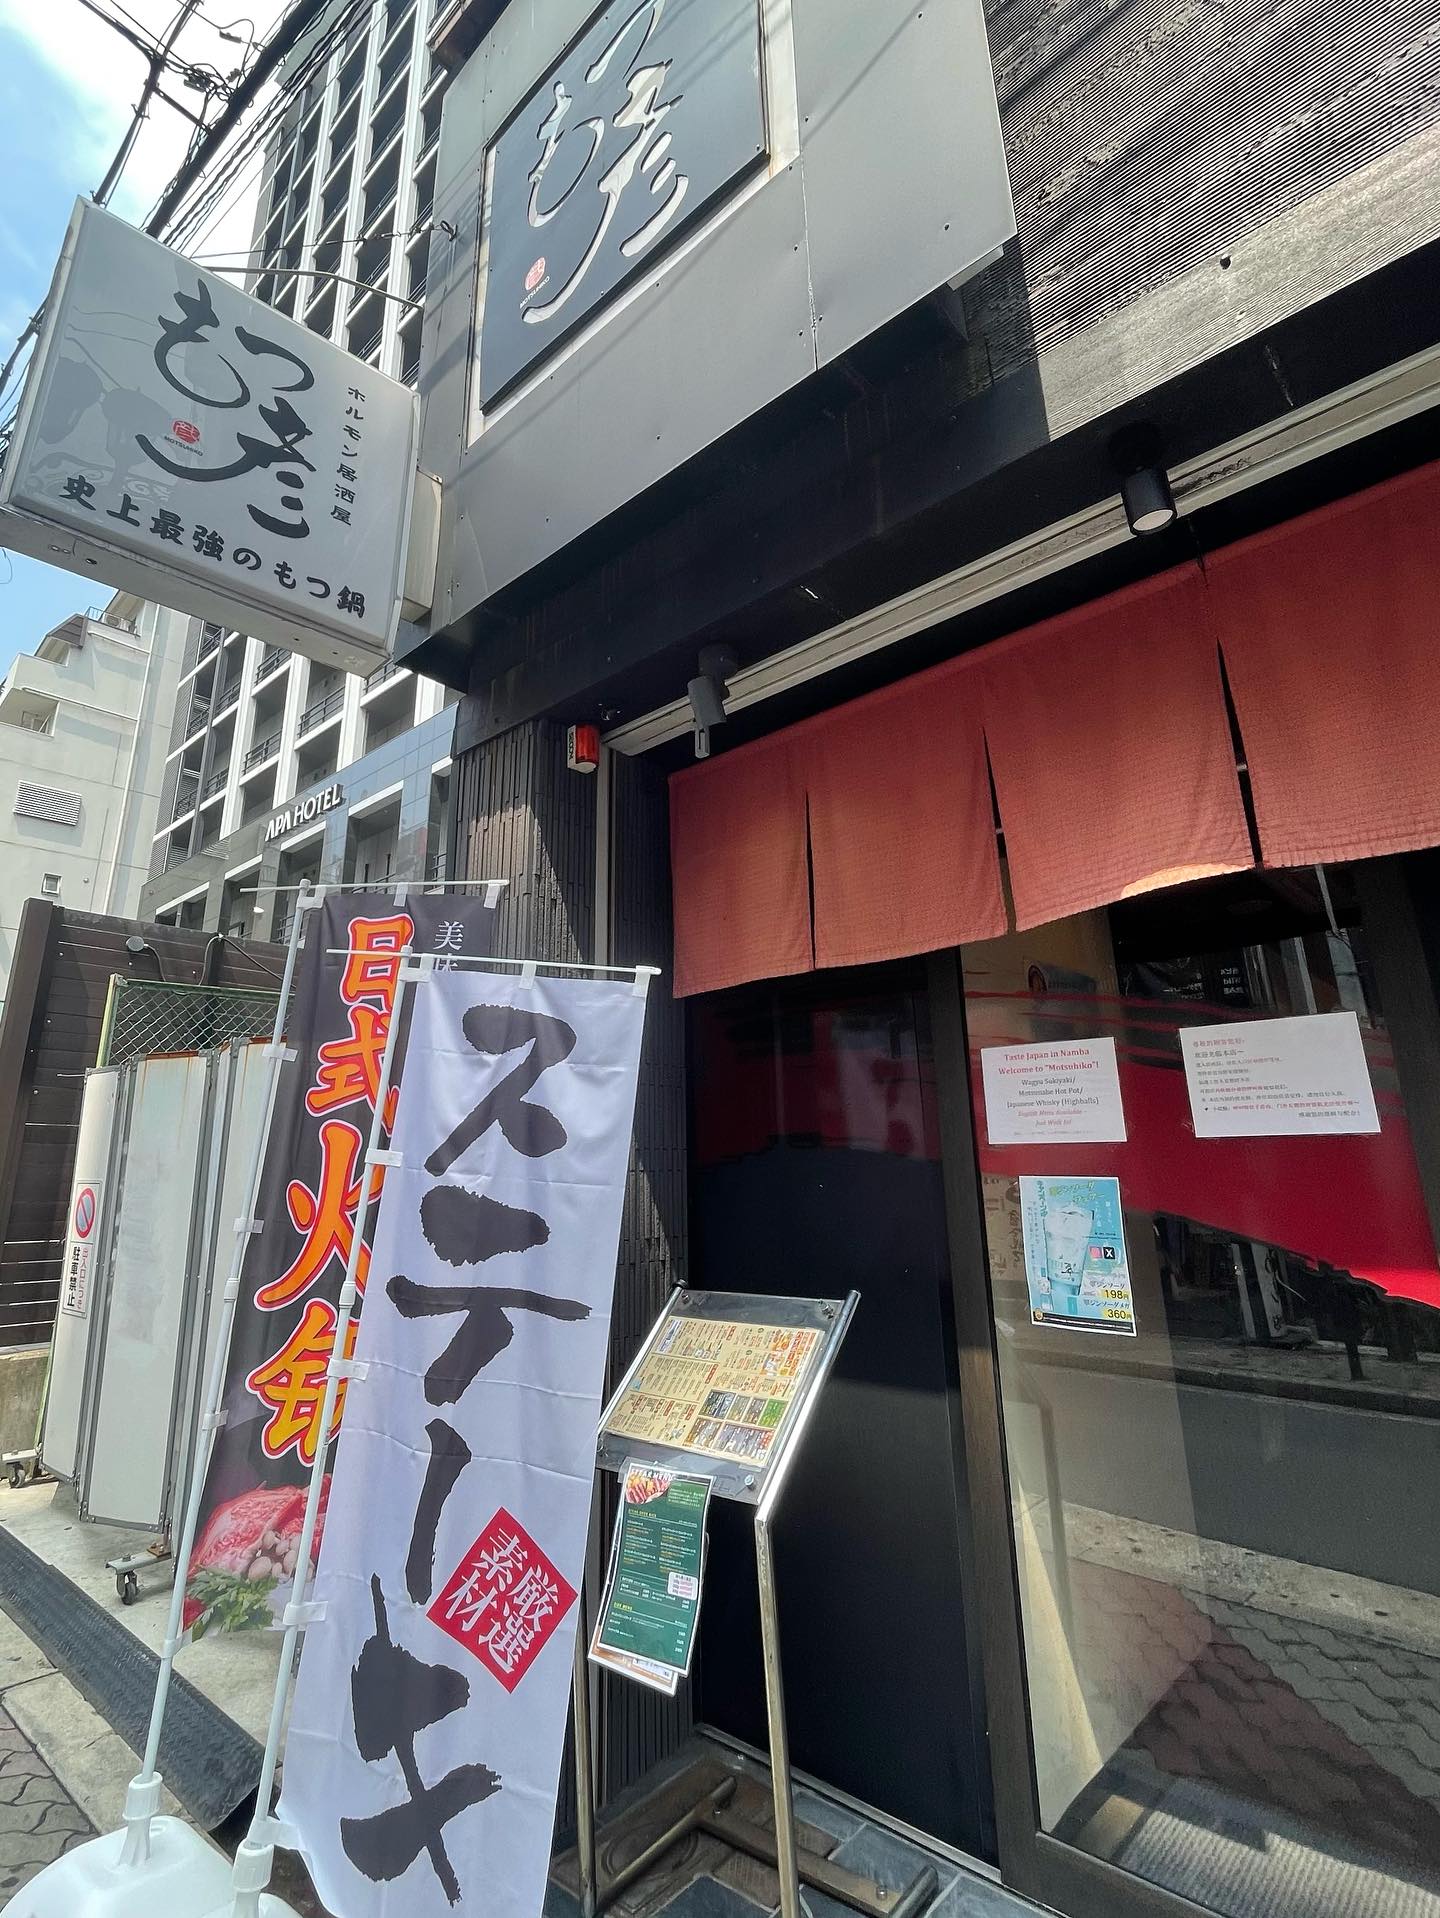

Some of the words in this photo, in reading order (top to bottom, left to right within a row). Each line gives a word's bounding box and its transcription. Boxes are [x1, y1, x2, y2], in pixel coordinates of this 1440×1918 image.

[330, 386, 366, 527] ホルモン居酒屋
[59, 474, 366, 619] 史上最強のもつ鍋
[264, 810, 292, 842] APA
[293, 783, 343, 827] HOTEL
[998, 1066, 1033, 1075] Welcome
[1004, 1053, 1025, 1062] Taste
[1026, 1051, 1049, 1061] Japan
[1050, 1050, 1058, 1058] in
[1060, 1048, 1089, 1057] Namba
[1022, 1078, 1043, 1086] Wagyu
[1068, 1086, 1084, 1094] Pot/
[1007, 1100, 1034, 1108] Japanese
[341, 1003, 592, 1908] ステーキ
[445, 1527, 529, 1632] 素材
